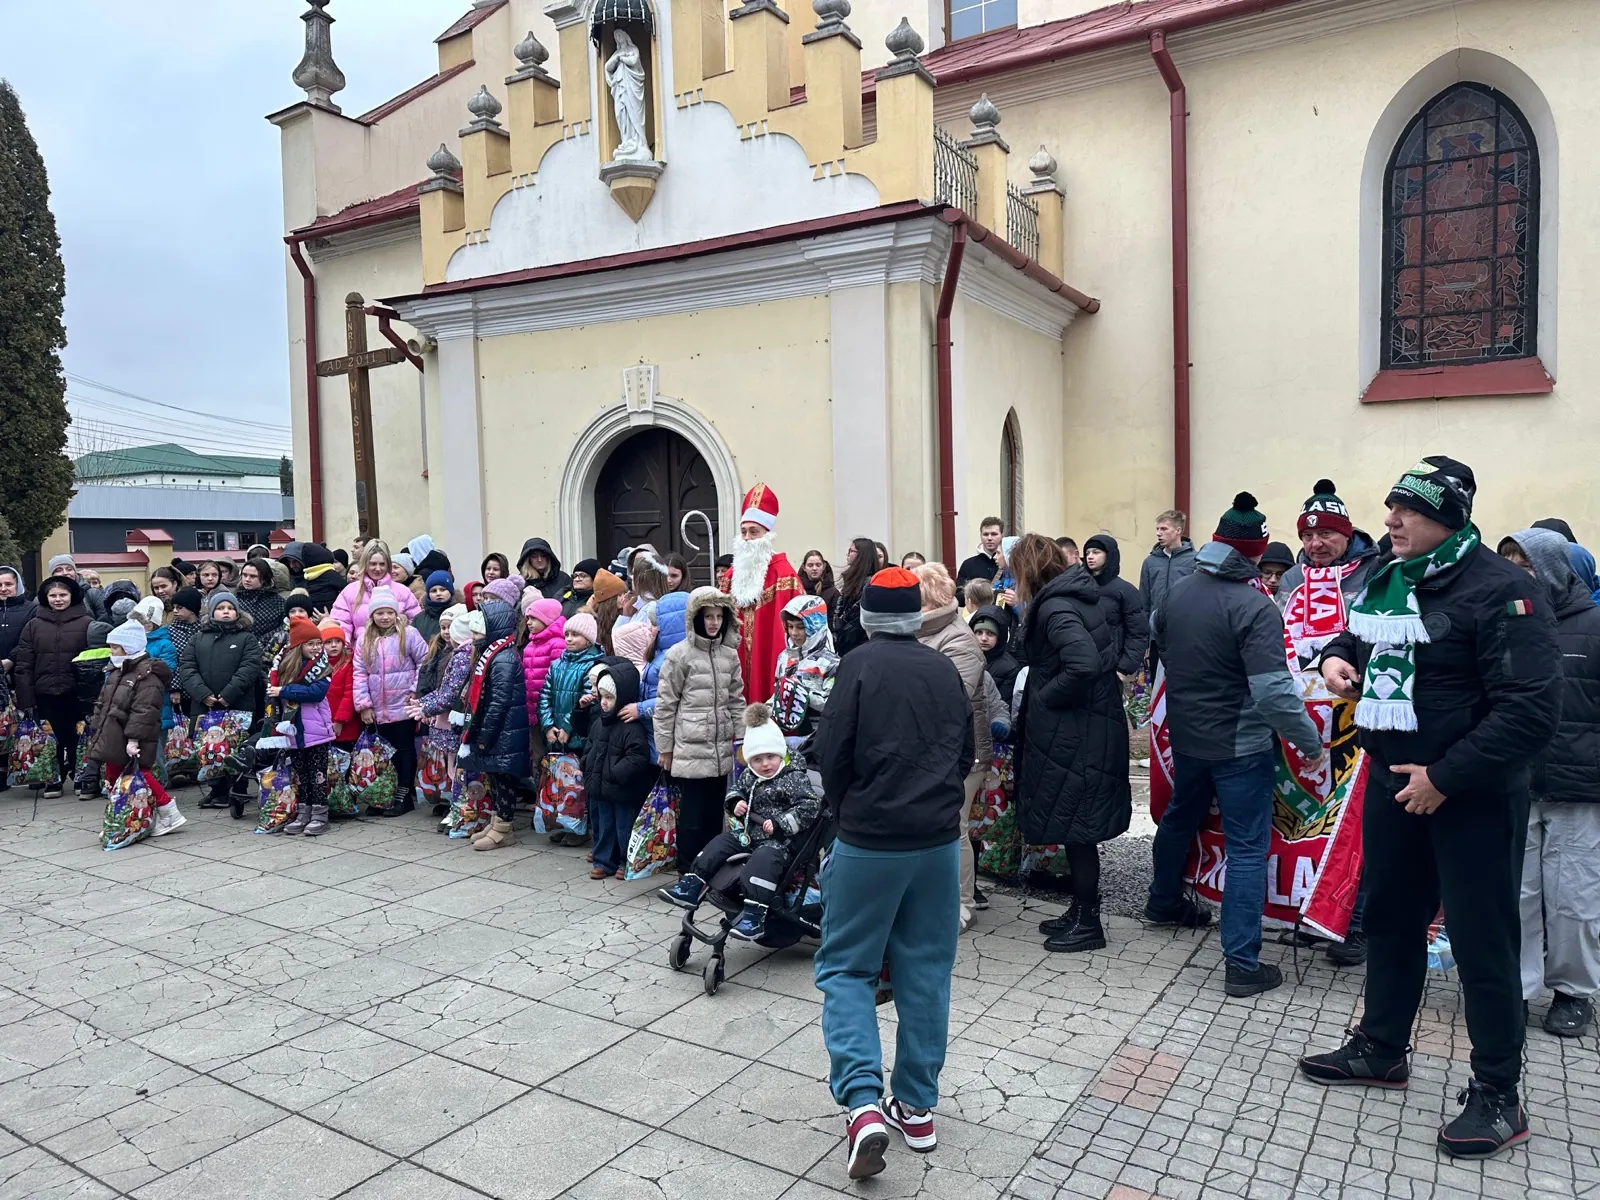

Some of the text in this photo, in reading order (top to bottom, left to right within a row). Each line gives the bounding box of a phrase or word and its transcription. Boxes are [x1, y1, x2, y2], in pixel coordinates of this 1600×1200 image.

[326, 352, 376, 372] AD 2011
[350, 381, 362, 461] MISJE
